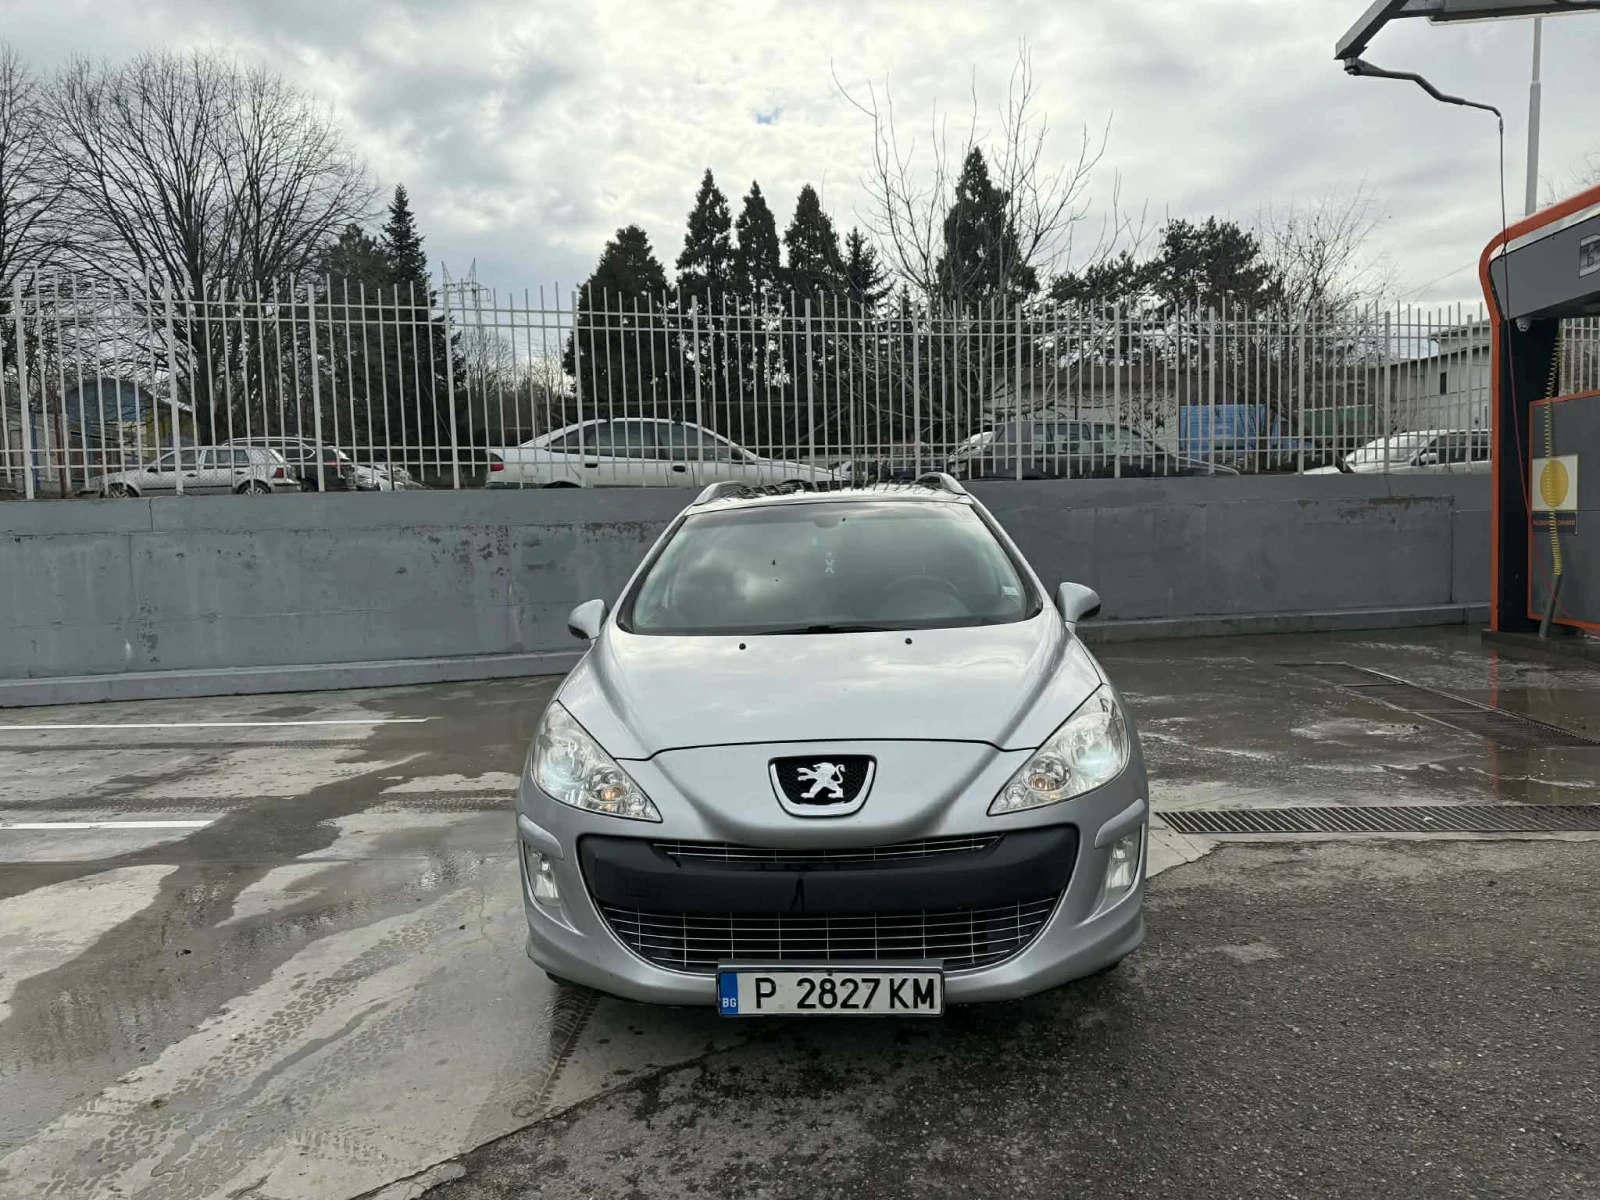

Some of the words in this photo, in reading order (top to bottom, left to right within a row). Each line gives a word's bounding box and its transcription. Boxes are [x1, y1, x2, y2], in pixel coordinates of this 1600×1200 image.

[722, 997, 737, 1008] BG
[755, 977, 777, 1009] P
[796, 977, 881, 1009] 2827
[889, 977, 935, 1009] KM
